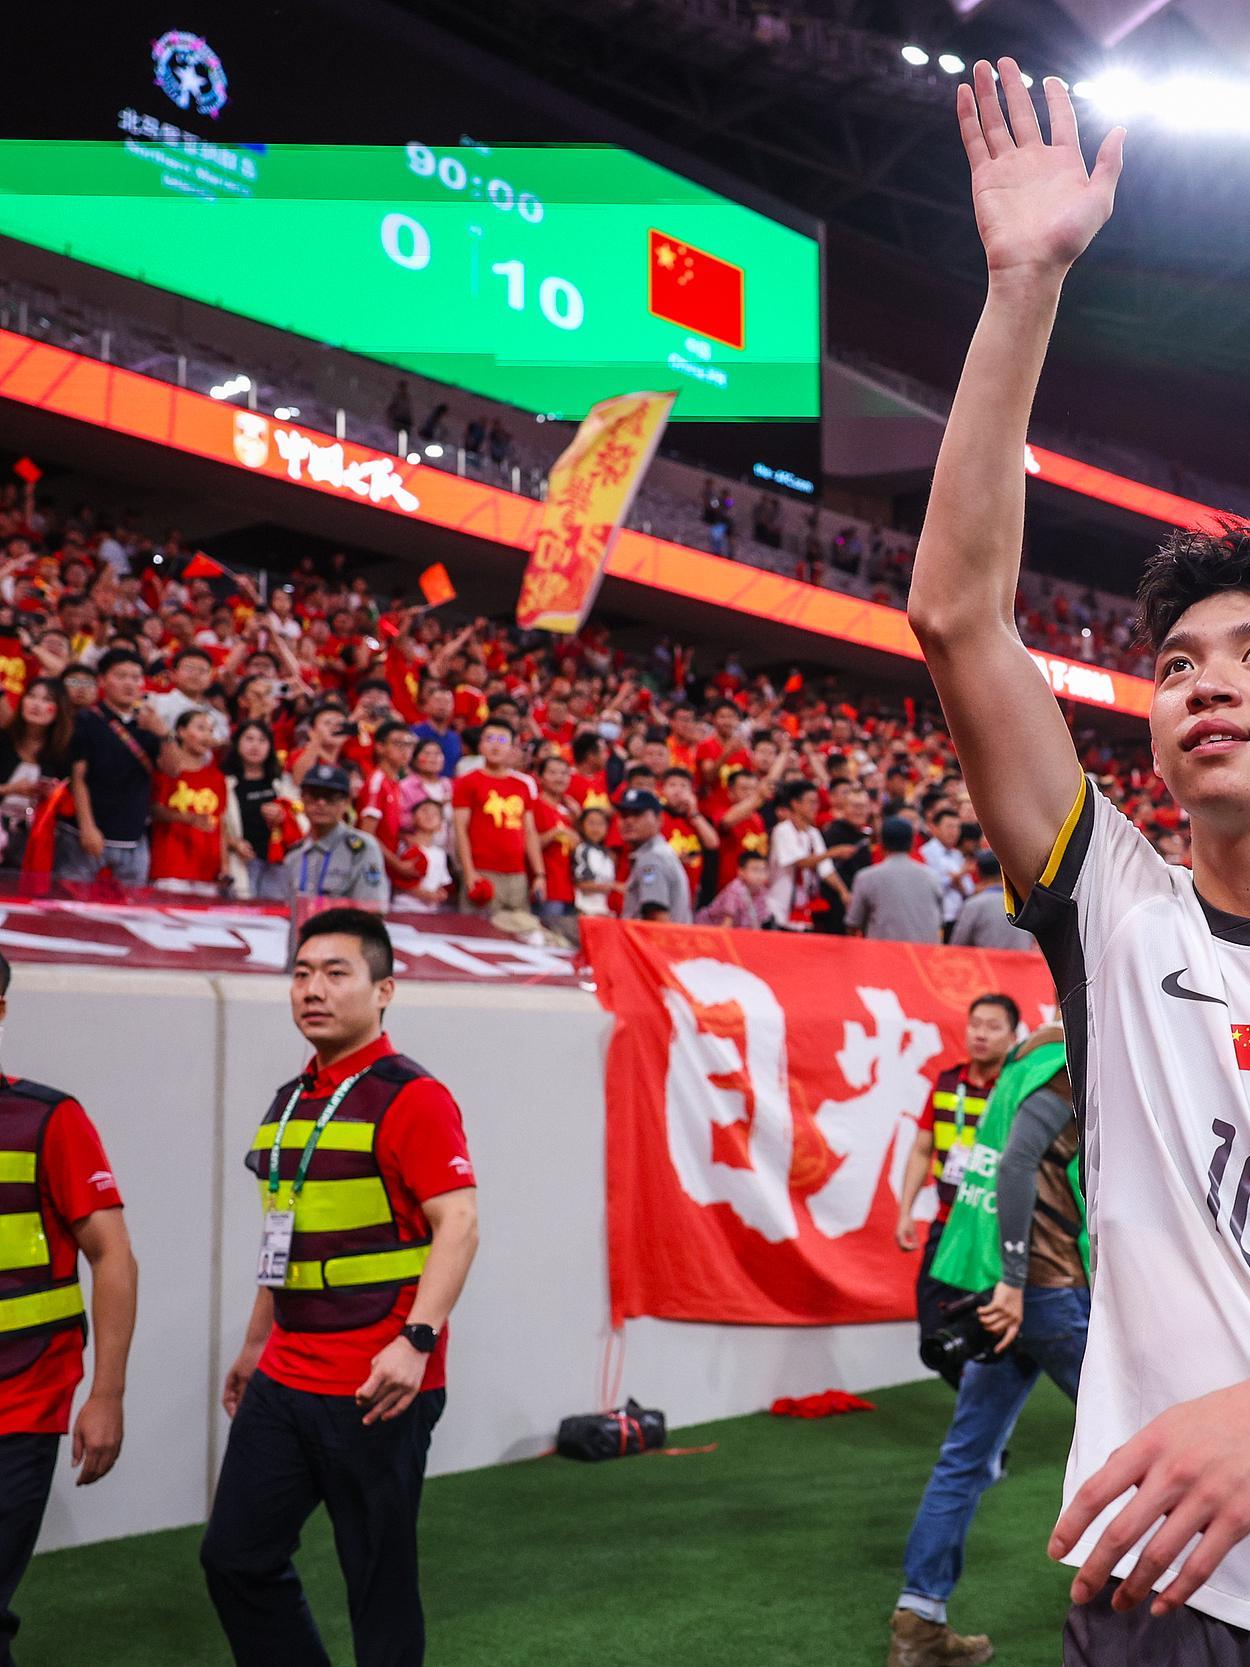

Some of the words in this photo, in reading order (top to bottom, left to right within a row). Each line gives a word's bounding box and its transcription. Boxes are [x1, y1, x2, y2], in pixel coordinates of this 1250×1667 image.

[406, 141, 544, 223] 90:00
[381, 213, 430, 270] 0
[492, 260, 584, 330] 10
